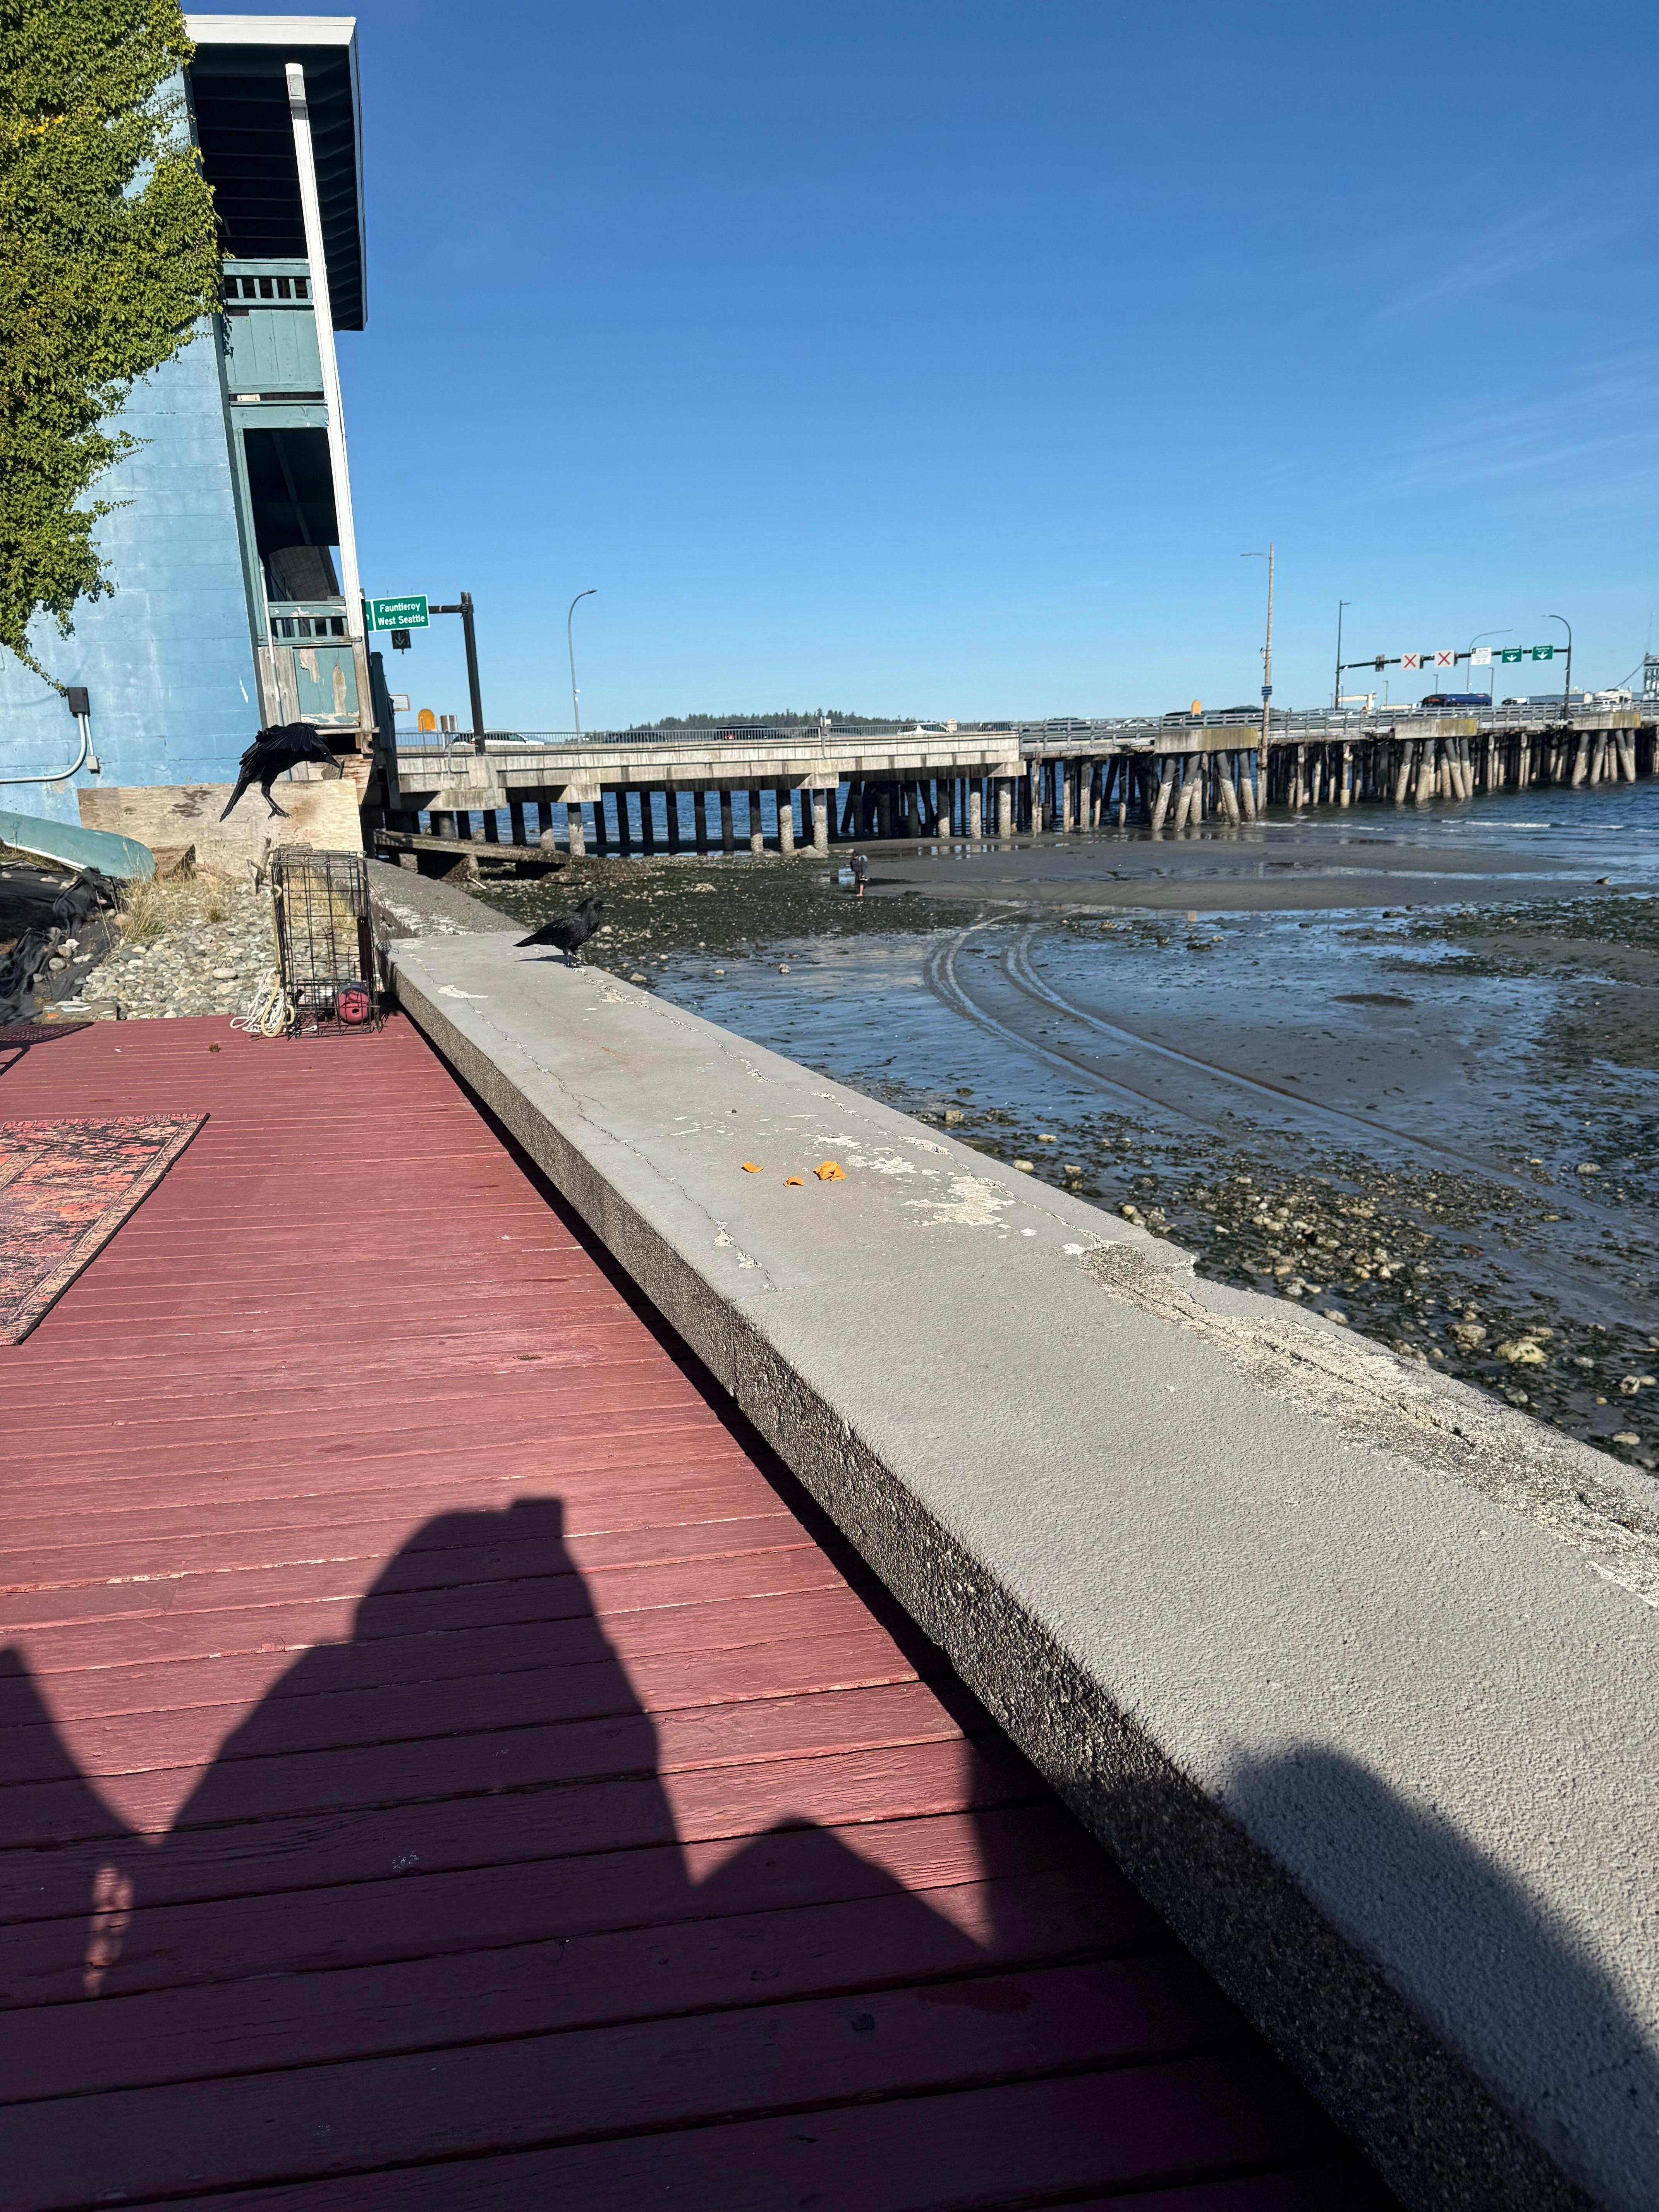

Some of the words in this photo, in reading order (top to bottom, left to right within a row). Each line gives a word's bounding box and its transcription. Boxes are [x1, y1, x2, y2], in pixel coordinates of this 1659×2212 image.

[380, 603, 420, 612] Fauntleroy
[378, 617, 396, 626] West
[398, 615, 425, 624] Seattle
